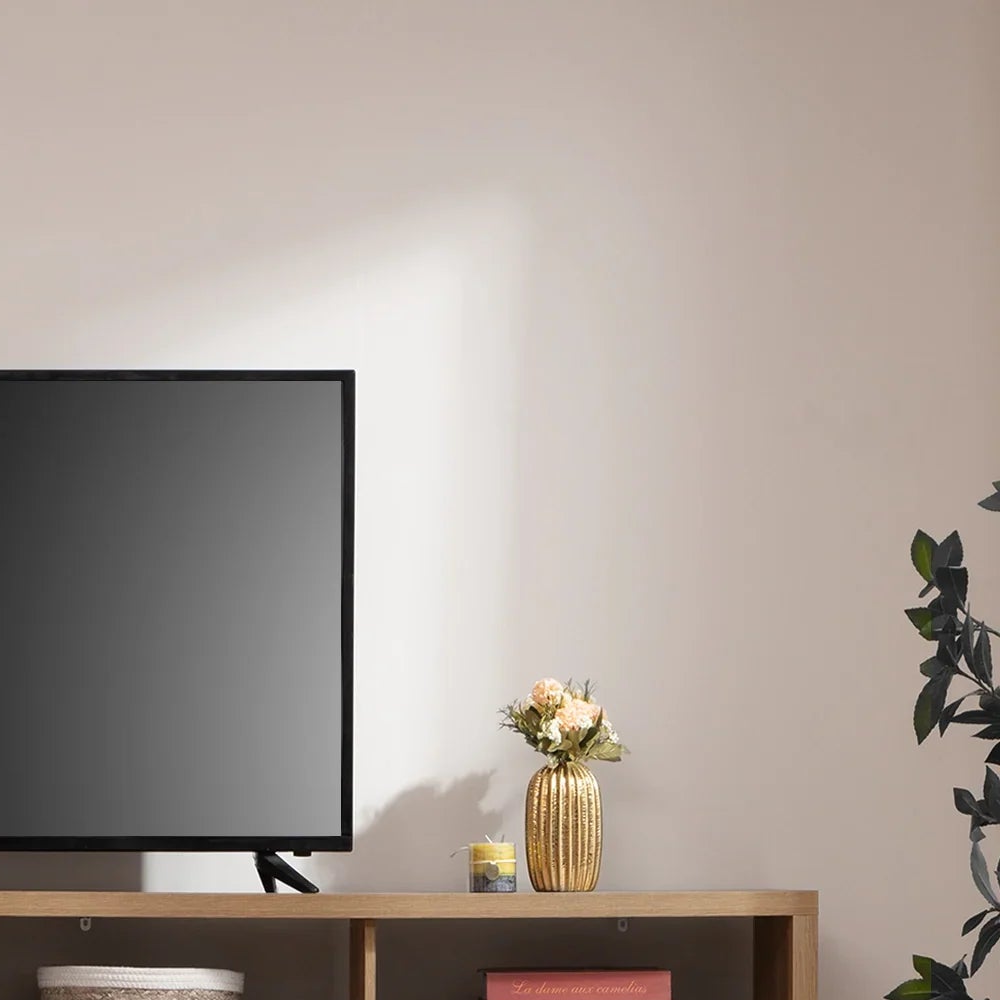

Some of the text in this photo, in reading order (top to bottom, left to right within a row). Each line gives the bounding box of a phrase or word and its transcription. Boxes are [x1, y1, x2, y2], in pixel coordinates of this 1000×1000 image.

[512, 980, 532, 995] La
[535, 982, 568, 994] dame
[571, 985, 594, 994] aux
